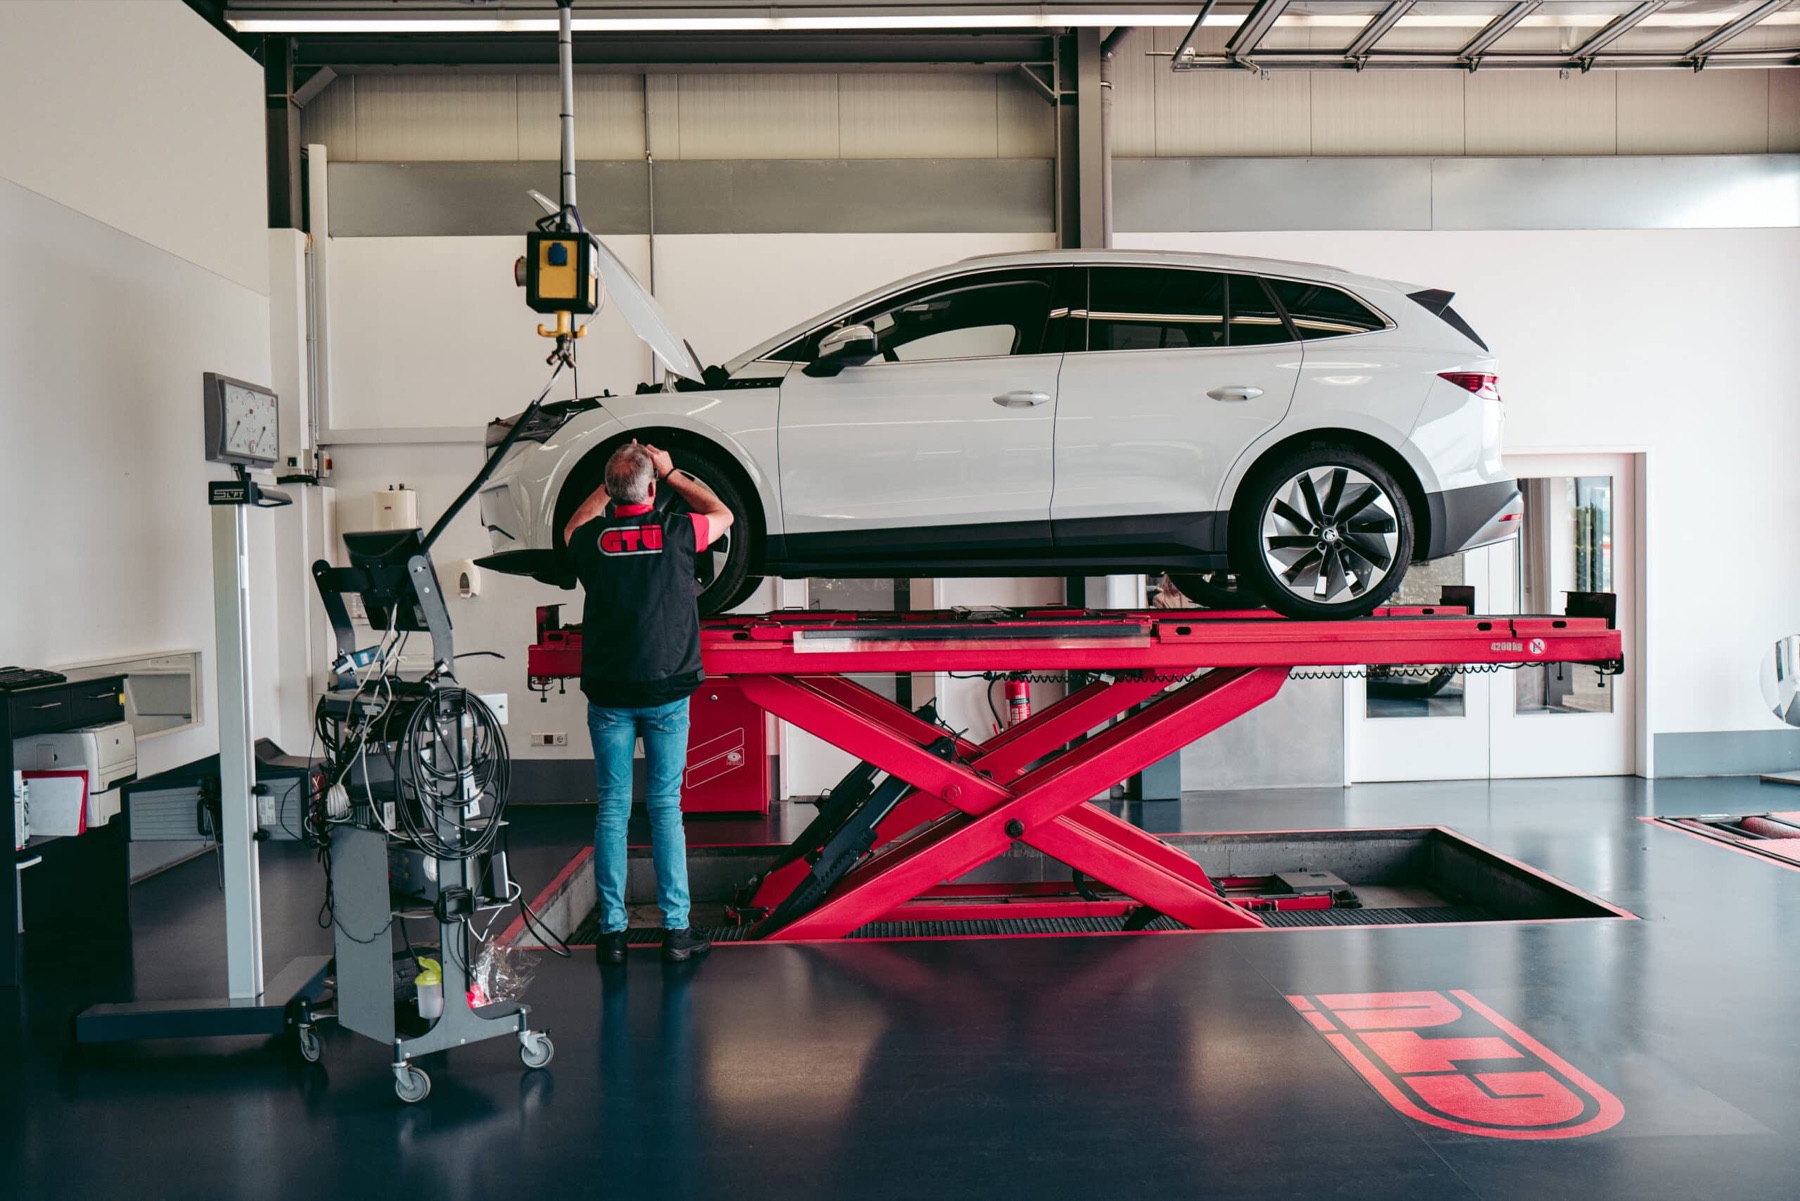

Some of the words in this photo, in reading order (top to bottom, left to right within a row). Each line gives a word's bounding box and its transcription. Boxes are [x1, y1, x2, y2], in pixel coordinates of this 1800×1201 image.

[601, 524, 663, 553] GTÜ
[1491, 641, 1511, 651] 4200
[1512, 641, 1523, 652] kg
